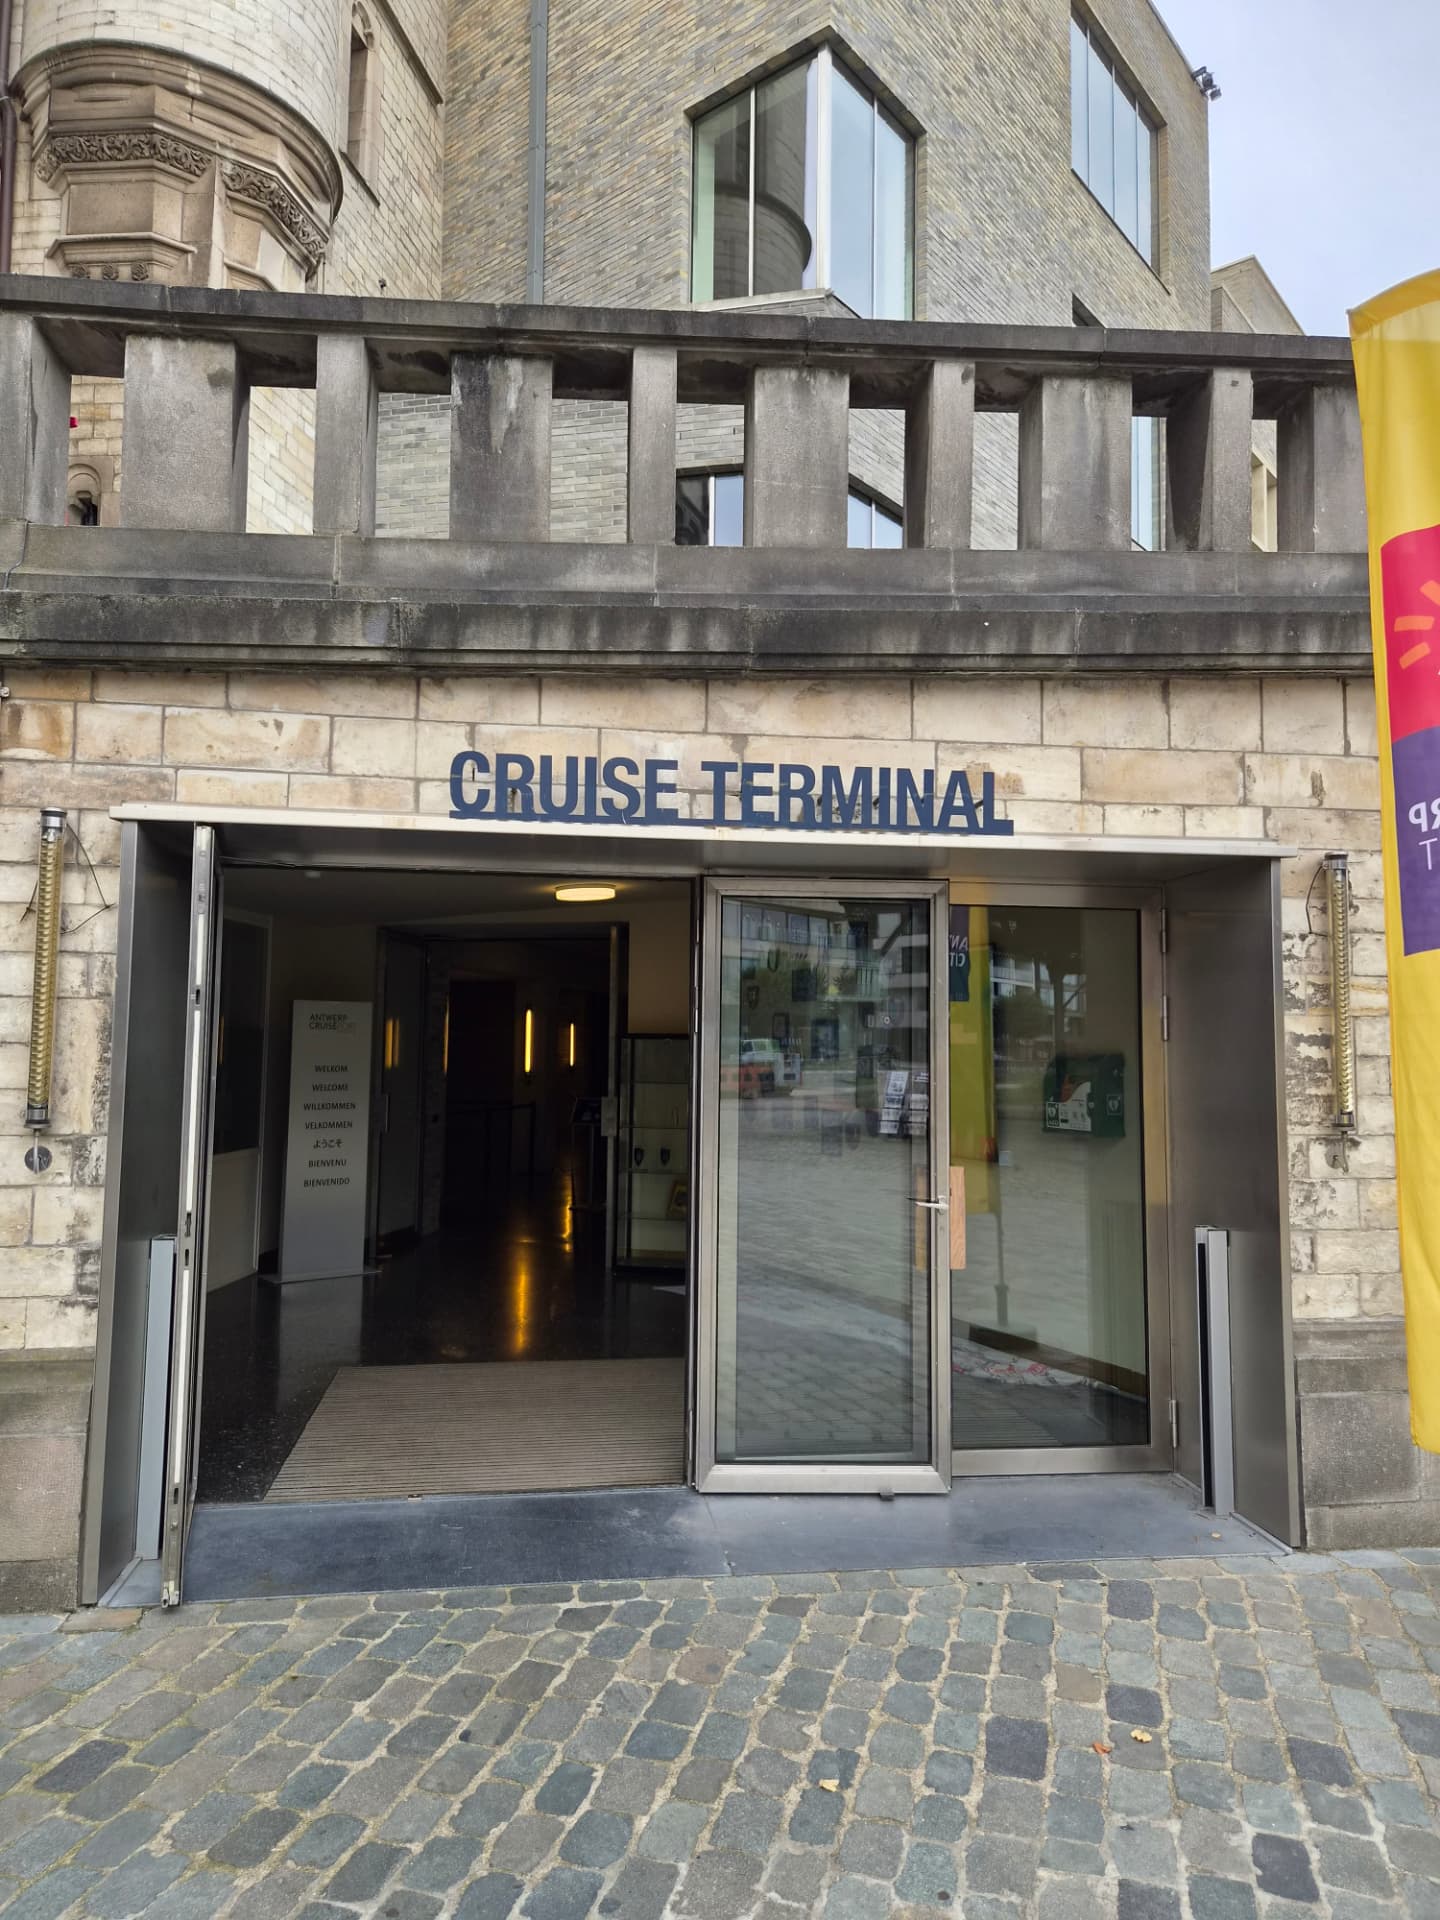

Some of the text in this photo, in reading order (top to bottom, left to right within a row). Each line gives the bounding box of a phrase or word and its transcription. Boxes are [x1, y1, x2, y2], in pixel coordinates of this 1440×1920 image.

[449, 750, 1014, 836] CRUISE TERMINAL
[314, 1064, 349, 1073] WELKOM
[312, 1083, 349, 1092] WELCOME
[303, 1102, 356, 1111] WILLKOMMEN
[305, 1120, 353, 1130] VELKOMMEN
[308, 1158, 347, 1168] BIENVENU
[303, 1177, 350, 1188] BIENVENIDO
